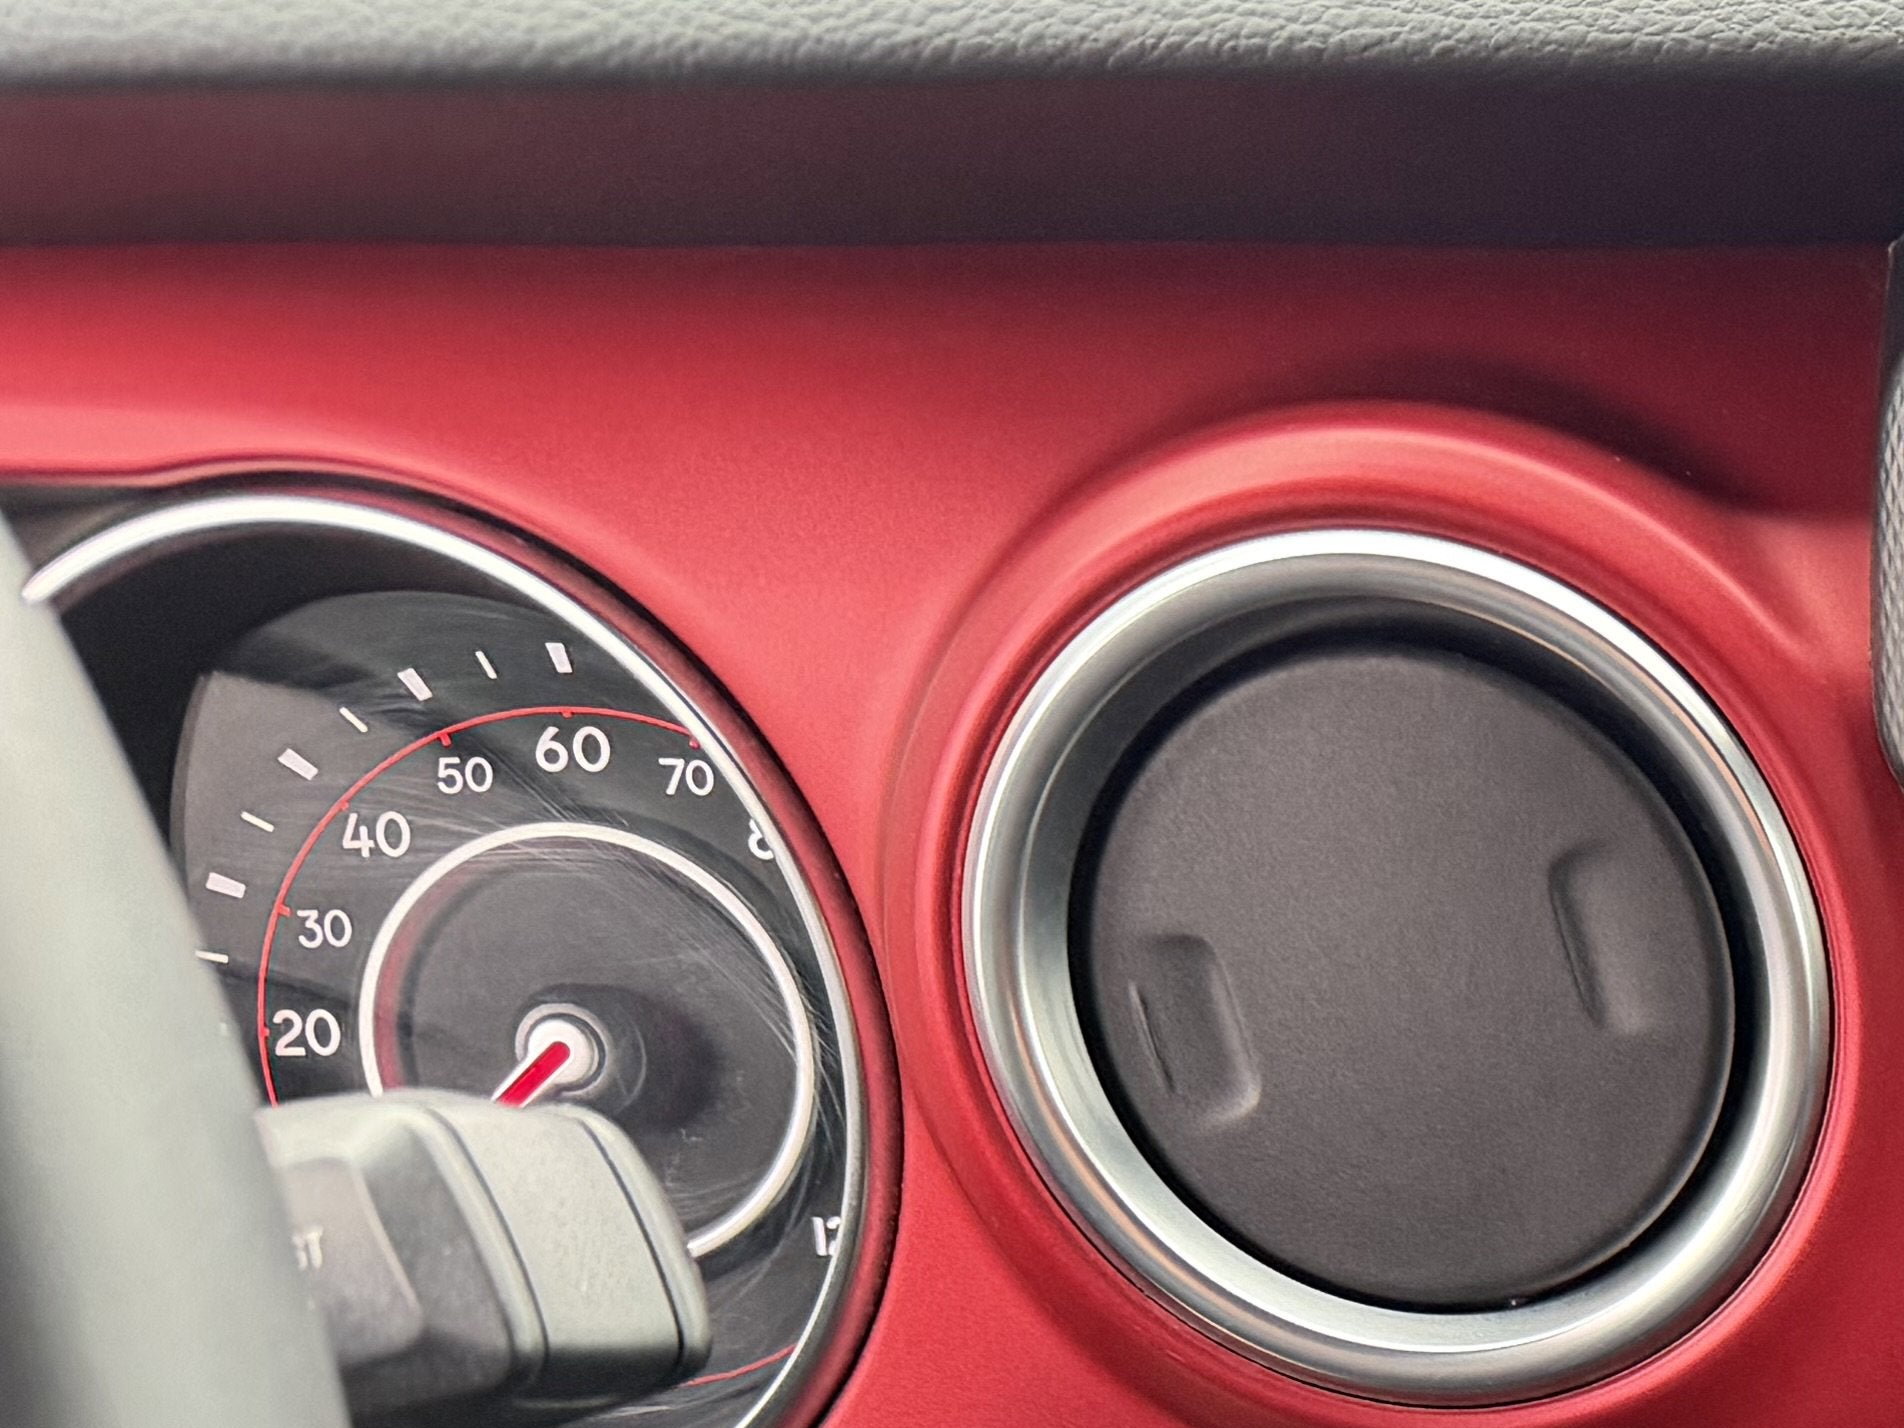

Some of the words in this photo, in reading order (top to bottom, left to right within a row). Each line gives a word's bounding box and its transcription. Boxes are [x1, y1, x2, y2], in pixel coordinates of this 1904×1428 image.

[535, 726, 611, 773] 60
[437, 756, 494, 795] 50
[658, 758, 714, 797] 70
[341, 811, 411, 859] 40
[296, 909, 352, 949] 30
[273, 1009, 341, 1058] 20
